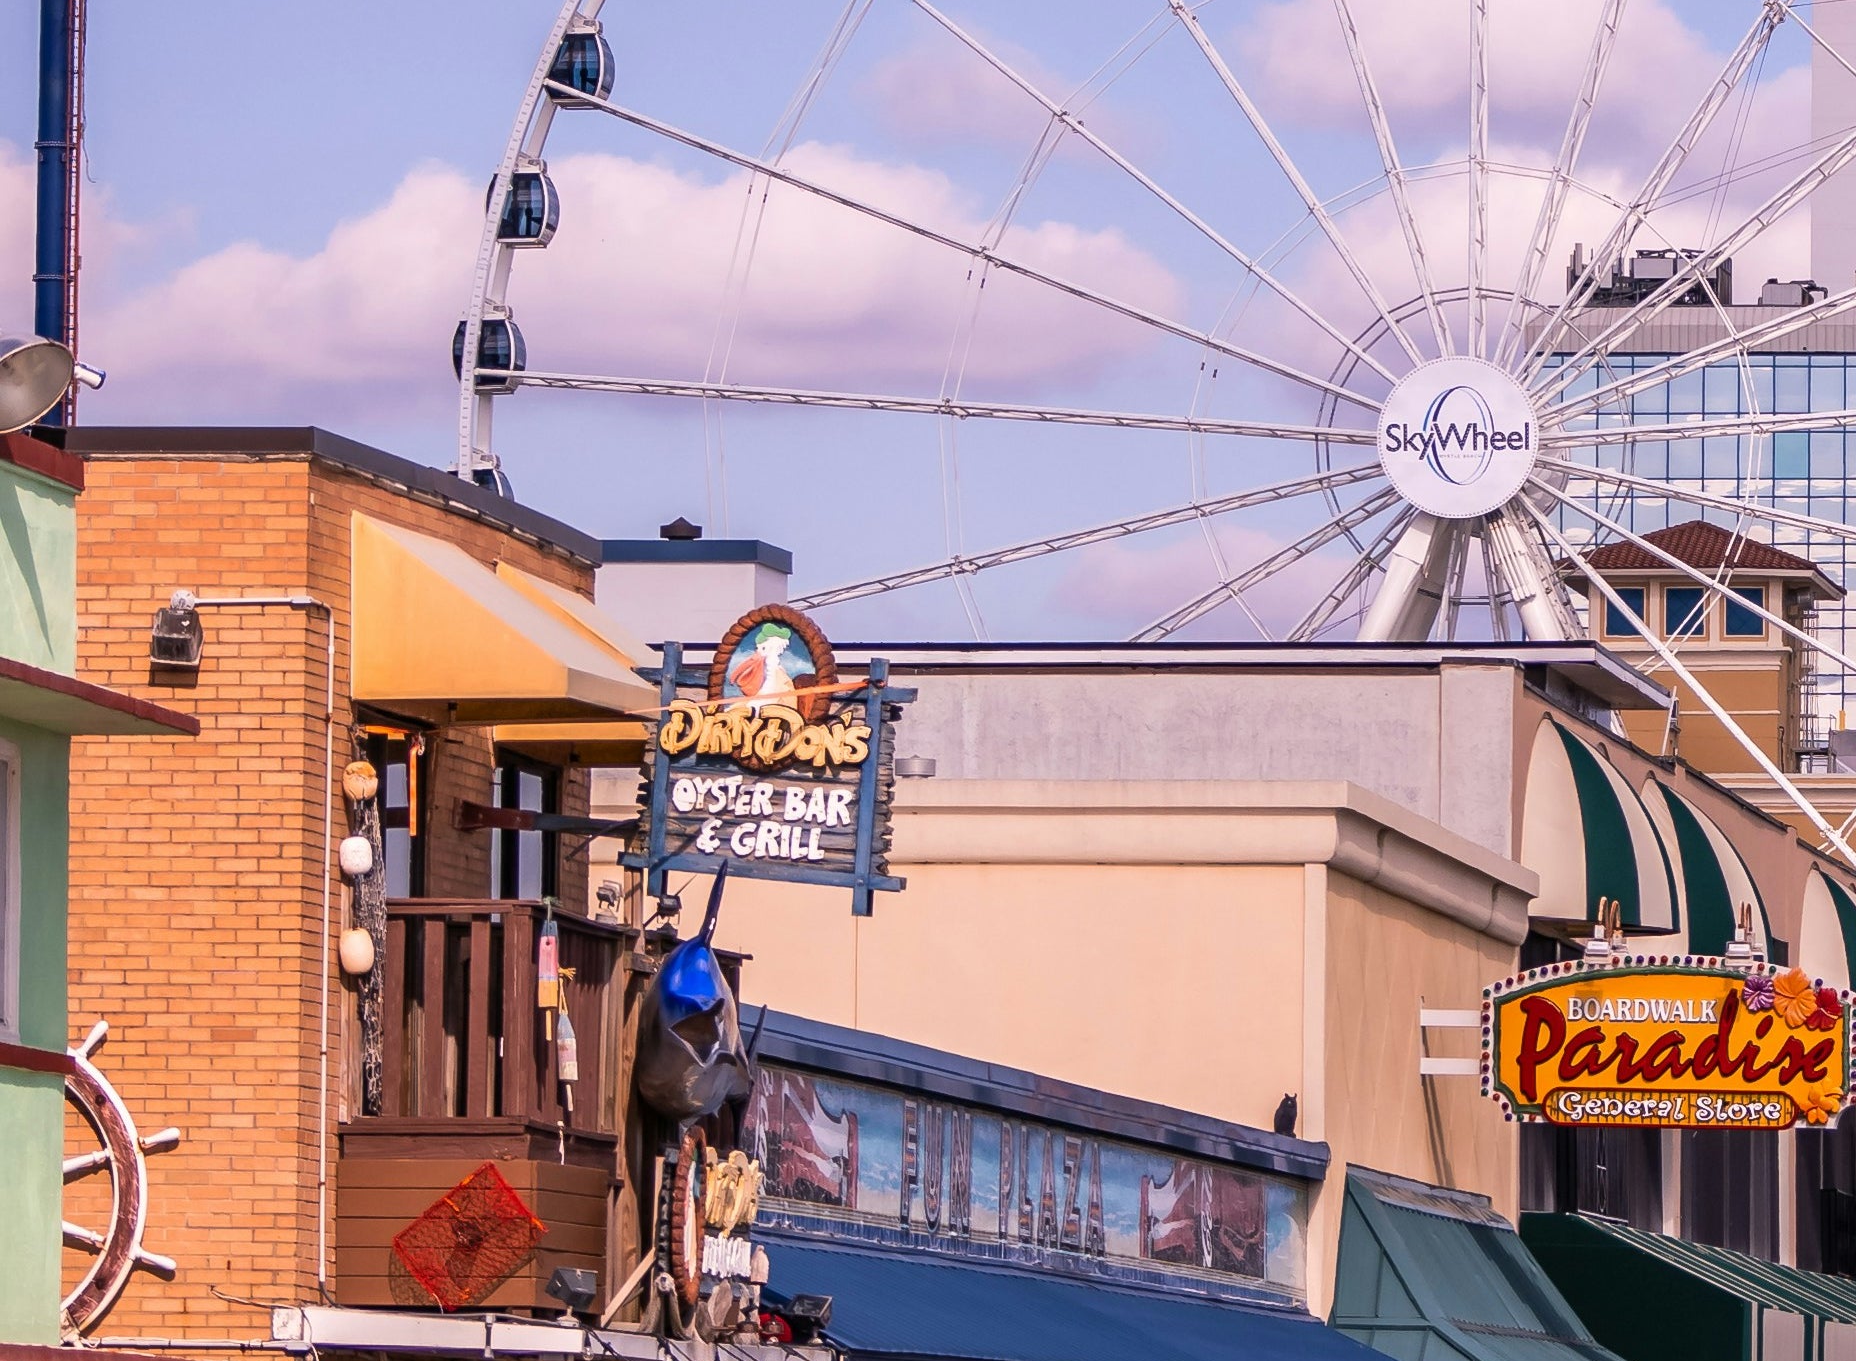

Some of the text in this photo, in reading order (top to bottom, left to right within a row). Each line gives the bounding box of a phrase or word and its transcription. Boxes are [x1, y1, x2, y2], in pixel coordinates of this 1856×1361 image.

[1386, 422, 1530, 460] SkyWheel
[672, 775, 853, 827] OYSTER BAR
[696, 818, 826, 861] & GRILL
[1567, 997, 1718, 1023] BOARDWALK
[1516, 988, 1836, 1102] Paradise
[1558, 1091, 1782, 1122] General Store
[900, 1100, 972, 1238] FUN
[999, 1121, 1105, 1260] PLAZA
